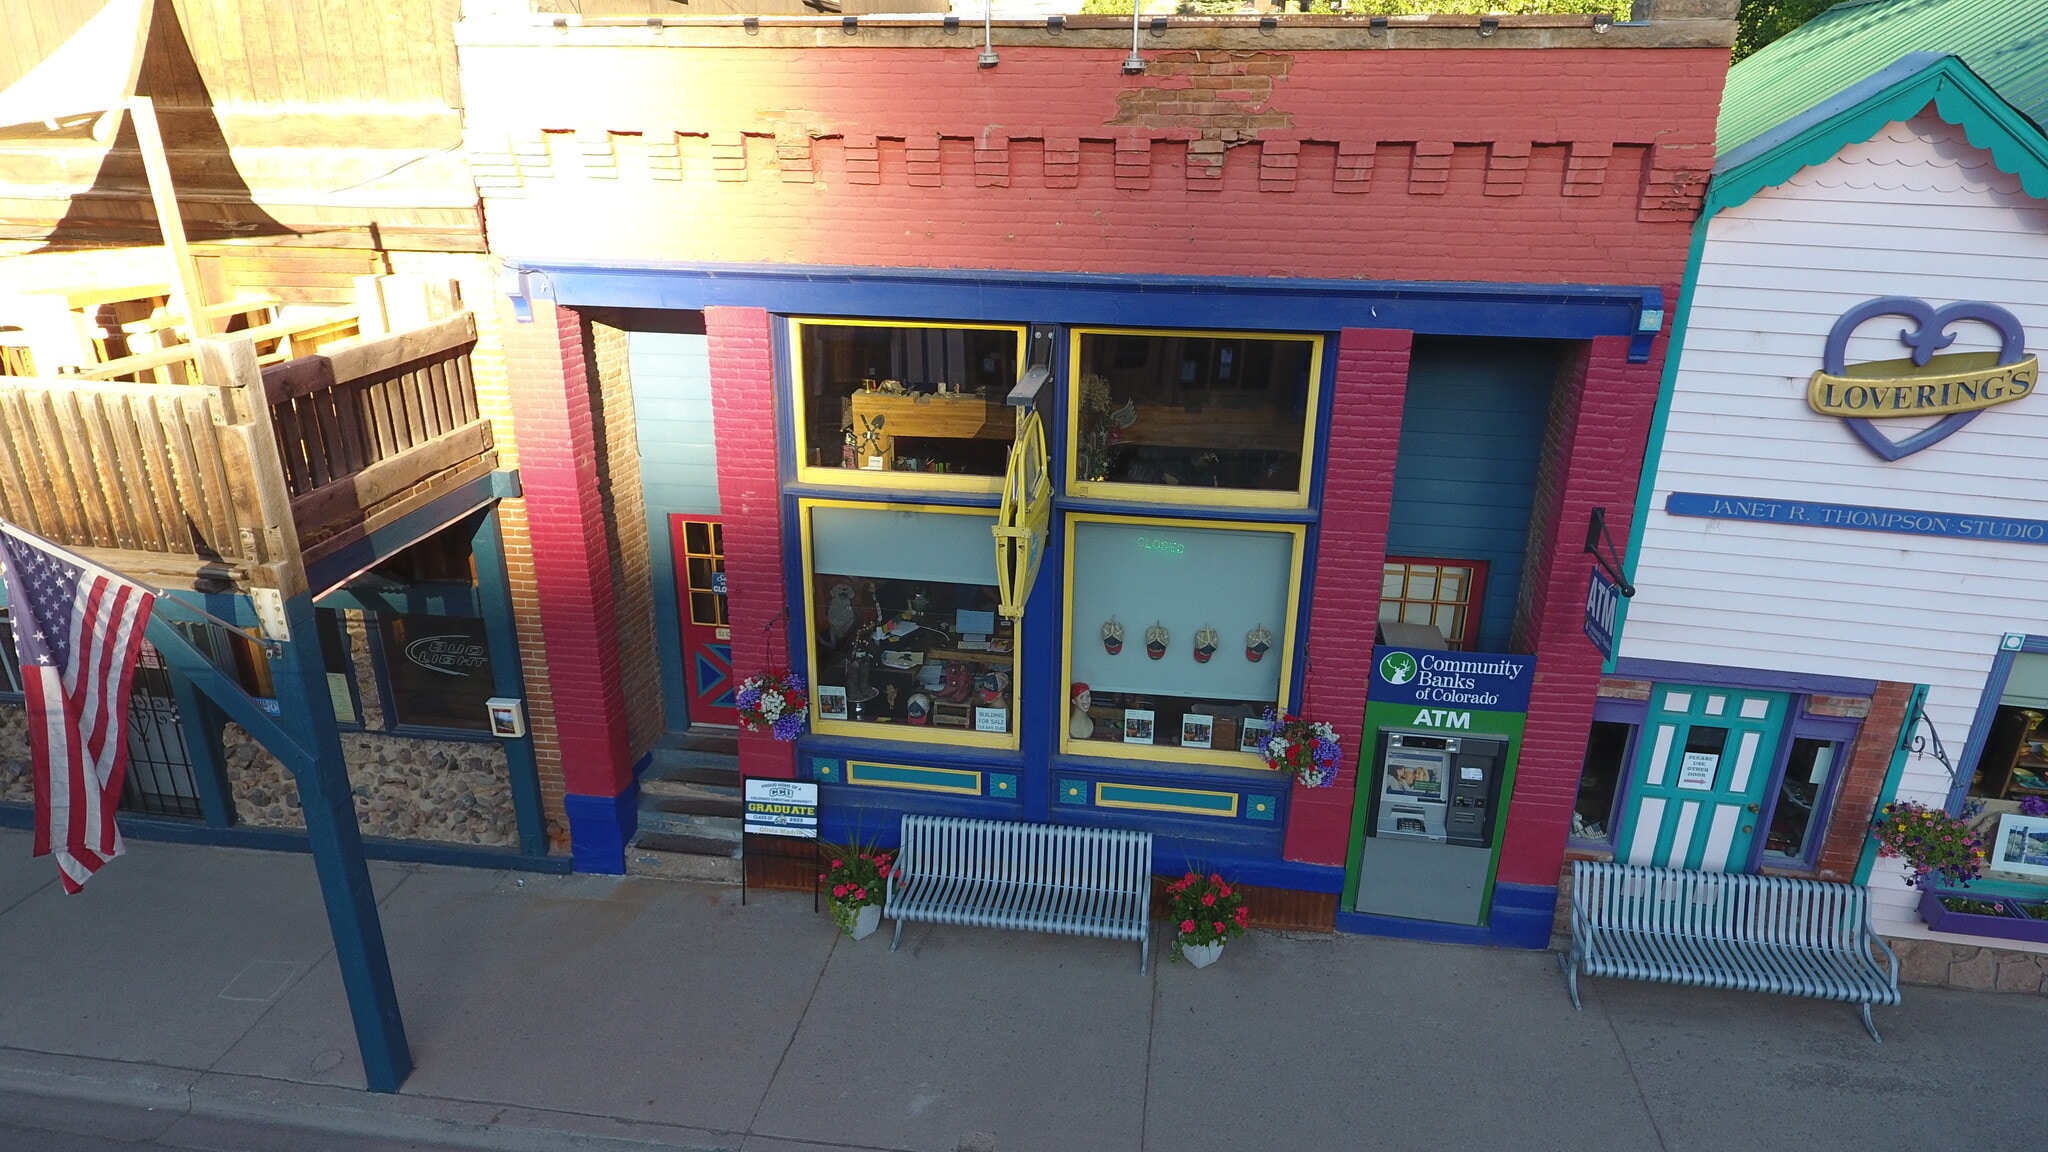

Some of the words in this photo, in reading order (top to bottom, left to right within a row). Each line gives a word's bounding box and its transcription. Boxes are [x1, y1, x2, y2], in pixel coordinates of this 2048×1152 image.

[1823, 369, 2031, 409] LOVERING'S
[1709, 499, 1782, 519] JANET
[1789, 505, 1811, 521] R.
[1821, 508, 1949, 532] THOMPSON
[1956, 519, 2045, 541] STUDIO
[1137, 536, 1185, 554] CLOSED
[1587, 575, 1617, 637] ATM
[429, 641, 484, 656] BUD
[418, 651, 488, 667] LIGHT
[1420, 654, 1525, 680] Community
[1417, 671, 1475, 689] Banks
[1416, 688, 1431, 700] of
[1432, 688, 1499, 705] Colorado
[1413, 708, 1471, 730] ATM
[769, 787, 794, 798] CCU
[748, 803, 815, 815] GRADUATE
